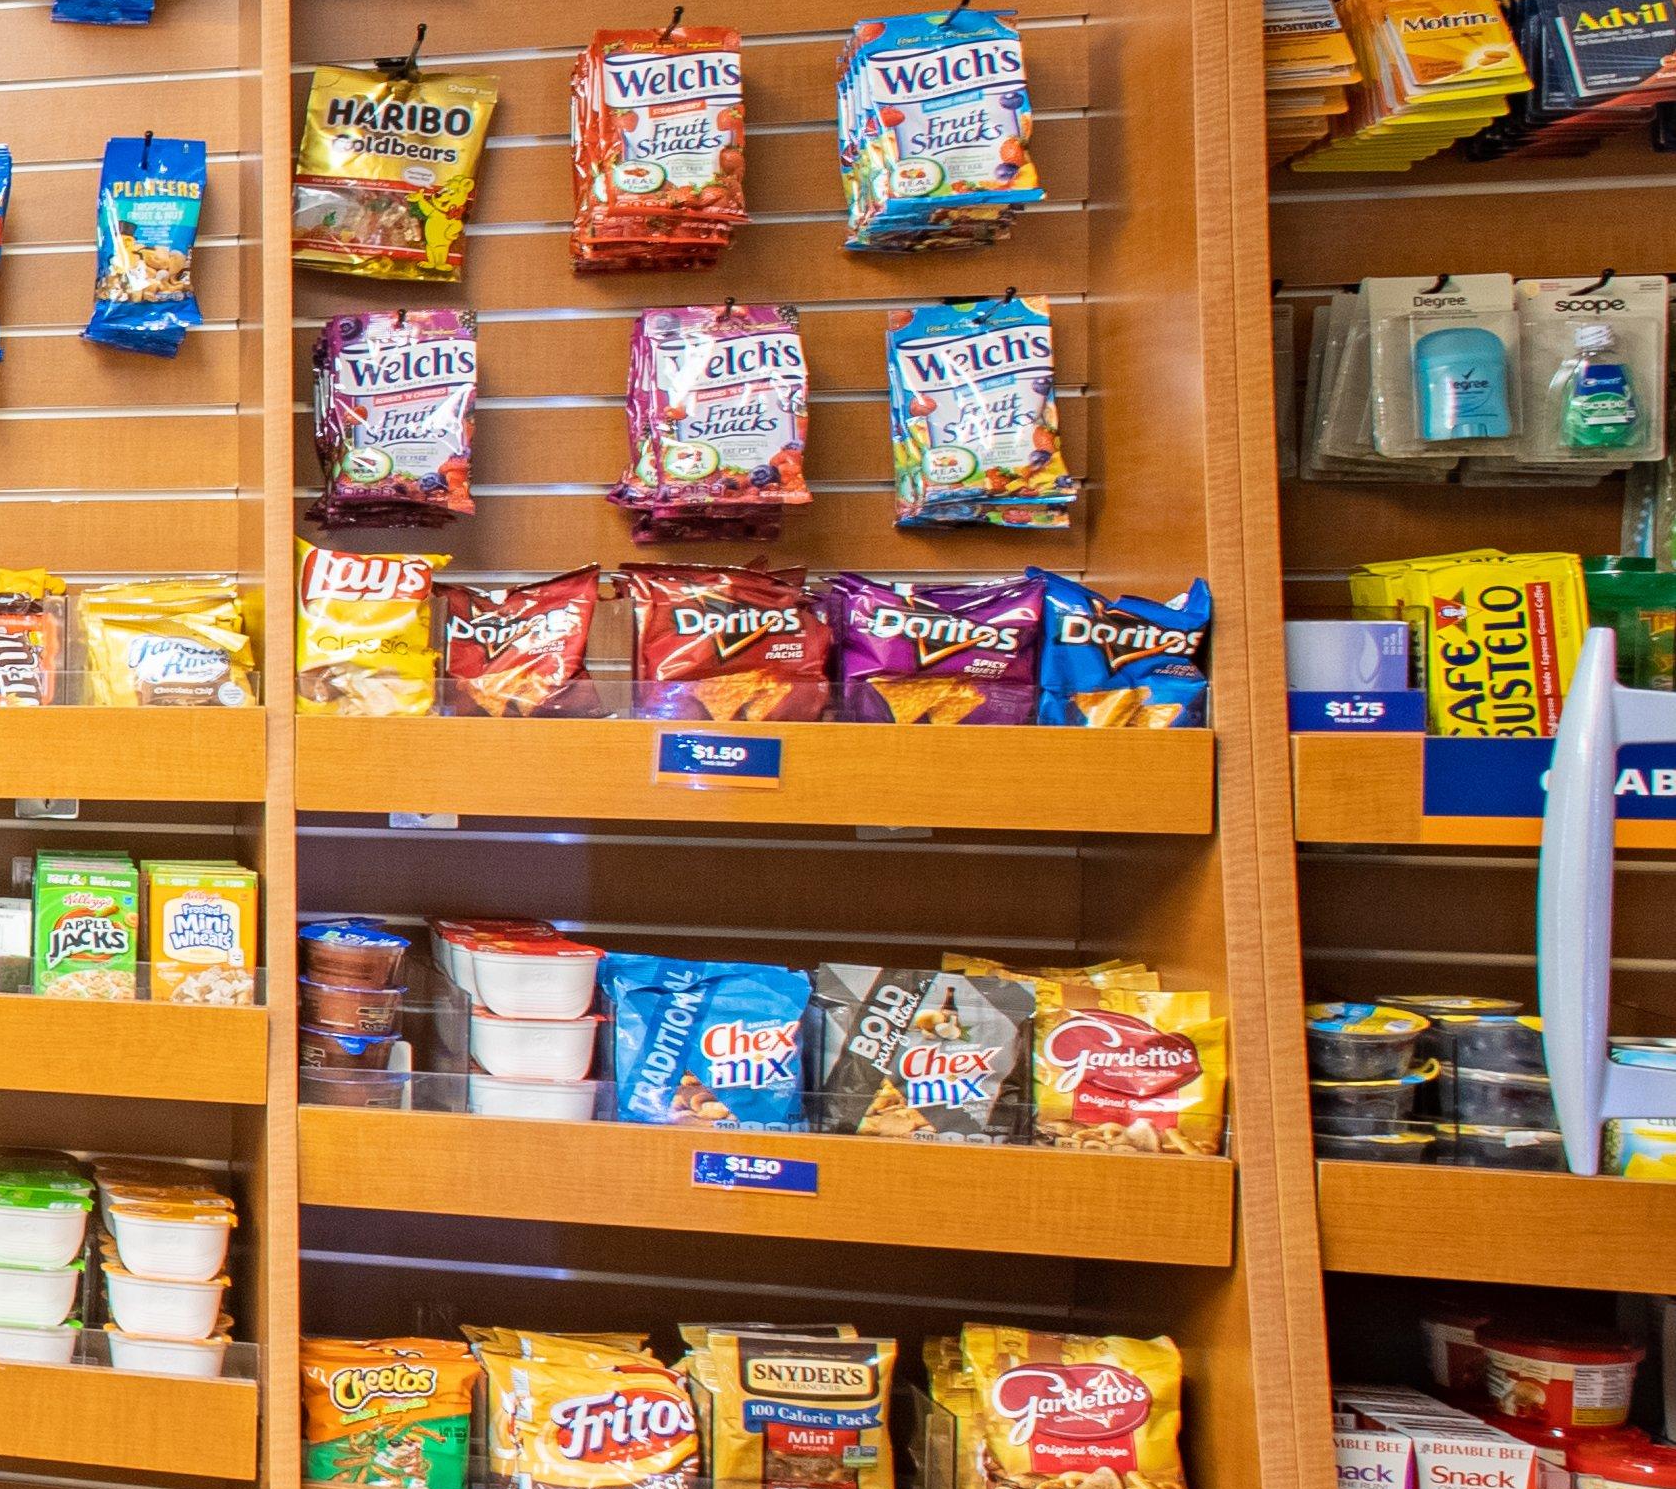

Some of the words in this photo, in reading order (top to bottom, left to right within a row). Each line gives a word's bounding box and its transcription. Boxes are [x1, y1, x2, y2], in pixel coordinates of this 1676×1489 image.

[1401, 11, 1488, 33] Motrin
[1574, 2, 1668, 31] Advil
[609, 50, 741, 99] Welch's
[877, 46, 1021, 97] Welch's
[327, 98, 474, 136] HARIBO
[651, 116, 711, 143] Fruit
[926, 110, 989, 136] Fruit
[331, 133, 458, 164] Goldbears
[636, 133, 722, 159] Snacks
[910, 126, 1002, 155] Snacks
[1413, 293, 1466, 309] Degree
[675, 608, 800, 636] Doritos
[876, 609, 1019, 652] Doritos
[1061, 612, 1204, 656] Doritos
[154, 687, 193, 695] Chocolate
[195, 687, 214, 696] Chip
[1325, 701, 1386, 717] $1.75
[691, 744, 746, 762] $1.50
[63, 918, 109, 931] APPLE
[49, 929, 126, 963] JACKS
[850, 983, 903, 1060] BOLD
[629, 969, 695, 1115] TRADITIONAL
[701, 1018, 797, 1057] Chex
[899, 1043, 997, 1078] Chex
[1043, 1016, 1194, 1092] Gardetto's
[709, 1052, 795, 1090] mix
[908, 1074, 993, 1110] mix
[725, 1156, 782, 1176] $1.50
[329, 1364, 437, 1412] Cheetos
[753, 1362, 866, 1388] SNYDER'S
[750, 1404, 775, 1419] 100
[779, 1407, 833, 1425] Calorie
[835, 1412, 872, 1429] Pack
[992, 1363, 1148, 1445] Gardetto's
[552, 1393, 696, 1458] Fritos
[787, 1430, 835, 1448] Mini
[1430, 1464, 1516, 1489] Snack
